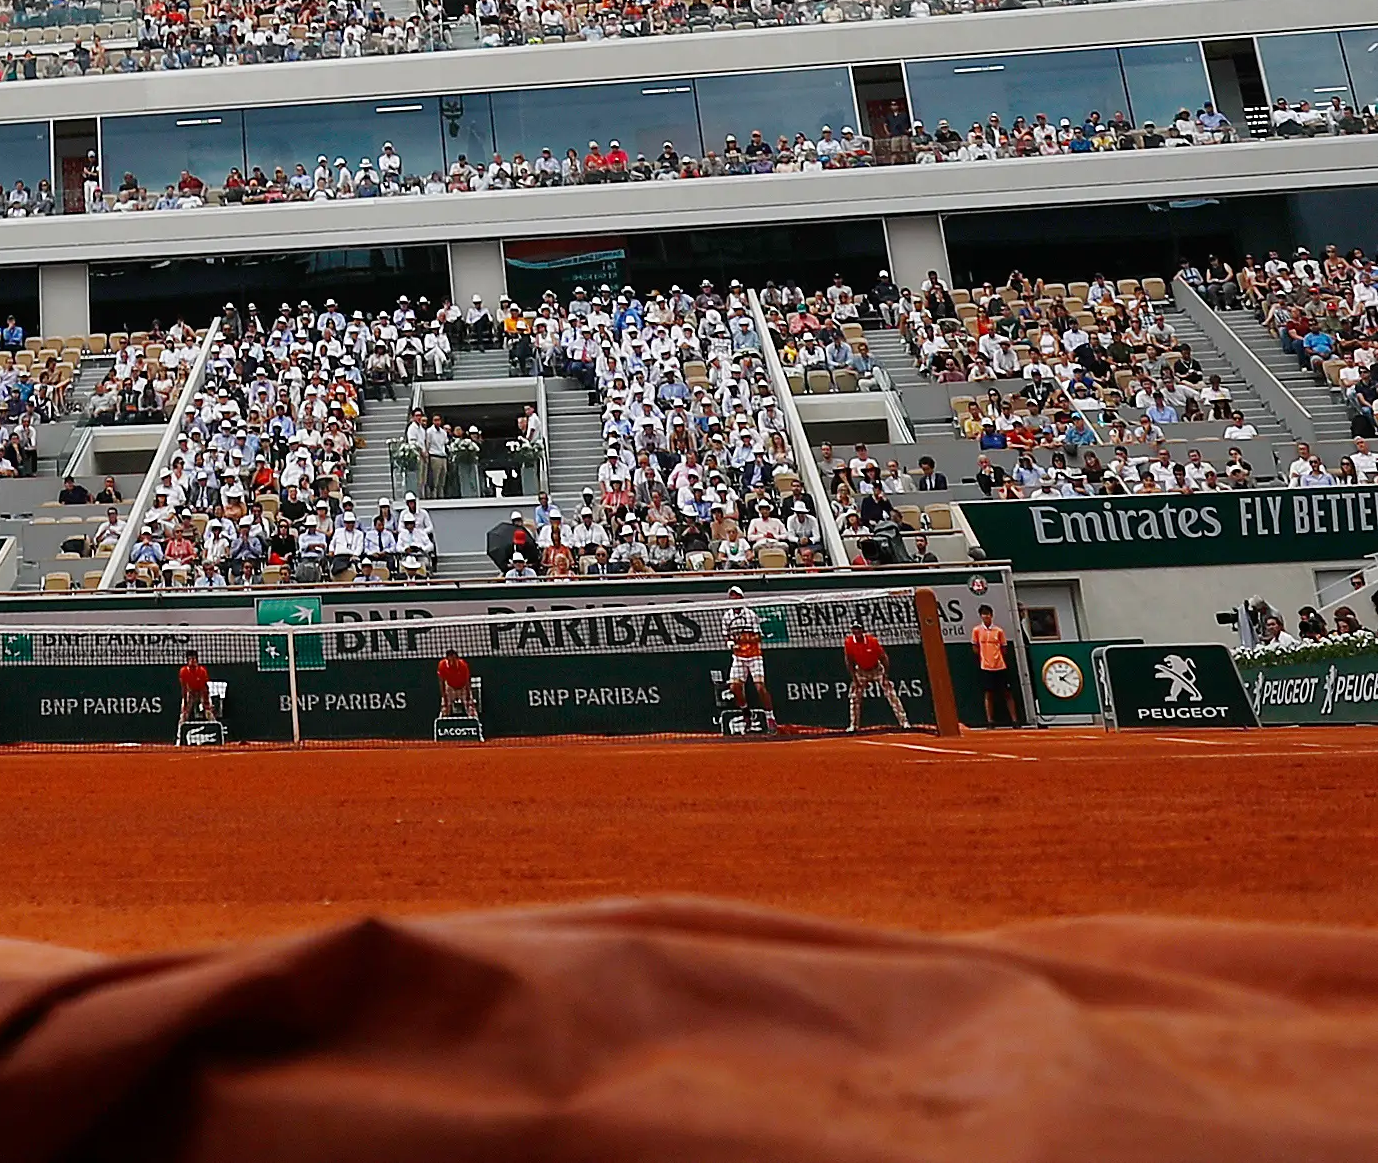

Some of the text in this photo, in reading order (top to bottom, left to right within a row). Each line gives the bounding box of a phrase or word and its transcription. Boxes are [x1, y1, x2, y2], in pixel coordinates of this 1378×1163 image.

[1028, 492, 1378, 543] Emirates FLY BETTE
[798, 603, 845, 627] BNP
[334, 600, 703, 653] BNP PARIBAS
[941, 626, 965, 636] orld
[528, 686, 662, 707] BNP PARIBAS
[786, 682, 830, 700] BNP
[1262, 672, 1378, 706] PEUGEOT PEUG
[40, 696, 163, 716] BNP PARIBAS
[279, 691, 408, 712] BNP PARIBAS
[1137, 706, 1229, 720] PEUGEOT
[437, 727, 478, 737] LACOSTE
